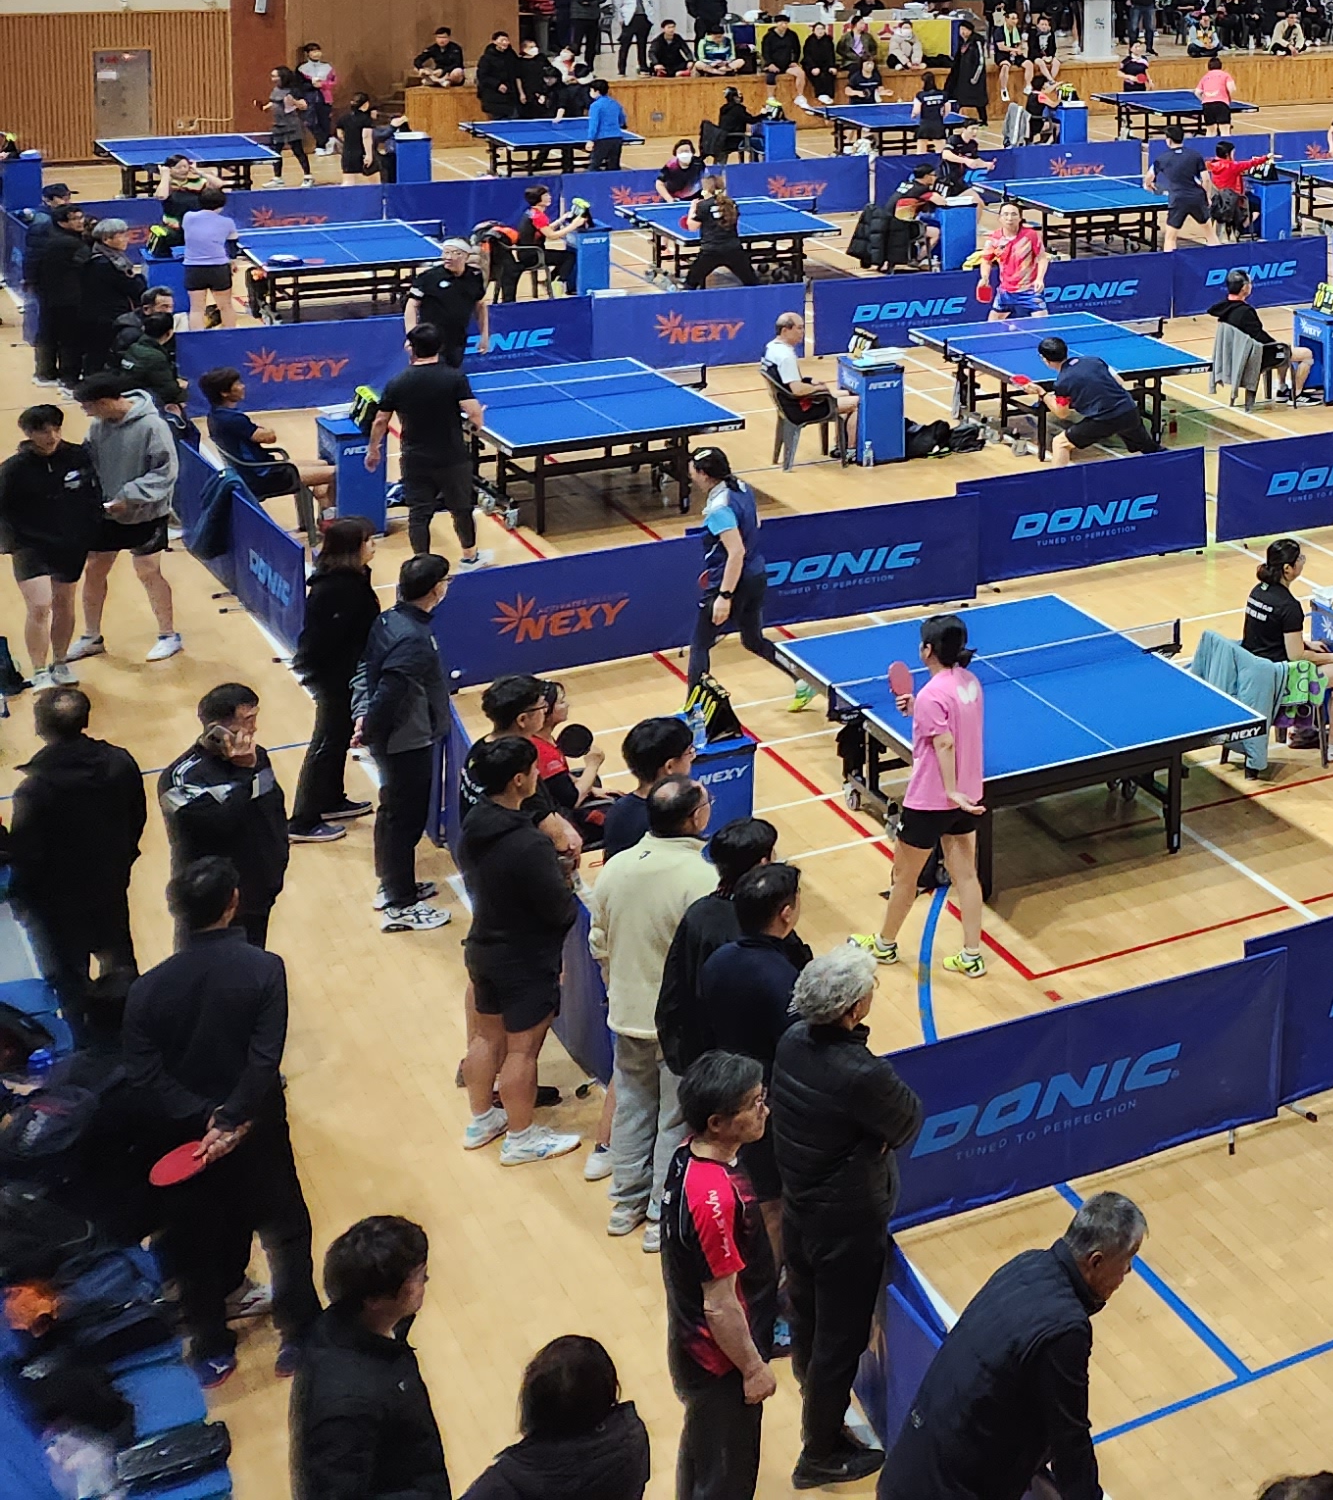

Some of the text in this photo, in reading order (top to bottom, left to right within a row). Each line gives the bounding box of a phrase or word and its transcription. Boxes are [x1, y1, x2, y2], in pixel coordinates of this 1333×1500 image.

[1205, 260, 1297, 287] DNIC
[851, 297, 967, 324] DONIC
[462, 328, 555, 354] ONIC
[671, 320, 745, 345] NEXY
[262, 357, 349, 383] NEXY
[1011, 494, 1159, 540] DONIC
[1036, 535, 1067, 547] TUNED
[1085, 525, 1137, 540] PERFECTION
[767, 542, 923, 587] DONIC
[833, 574, 894, 589] PERFECTION
[515, 598, 630, 644] NEXY
[1231, 725, 1262, 741] NEXY
[697, 764, 751, 786] NEXY
[910, 1041, 1183, 1160] DONIC
[955, 1099, 1139, 1162] TUNED TO PERFECTION
